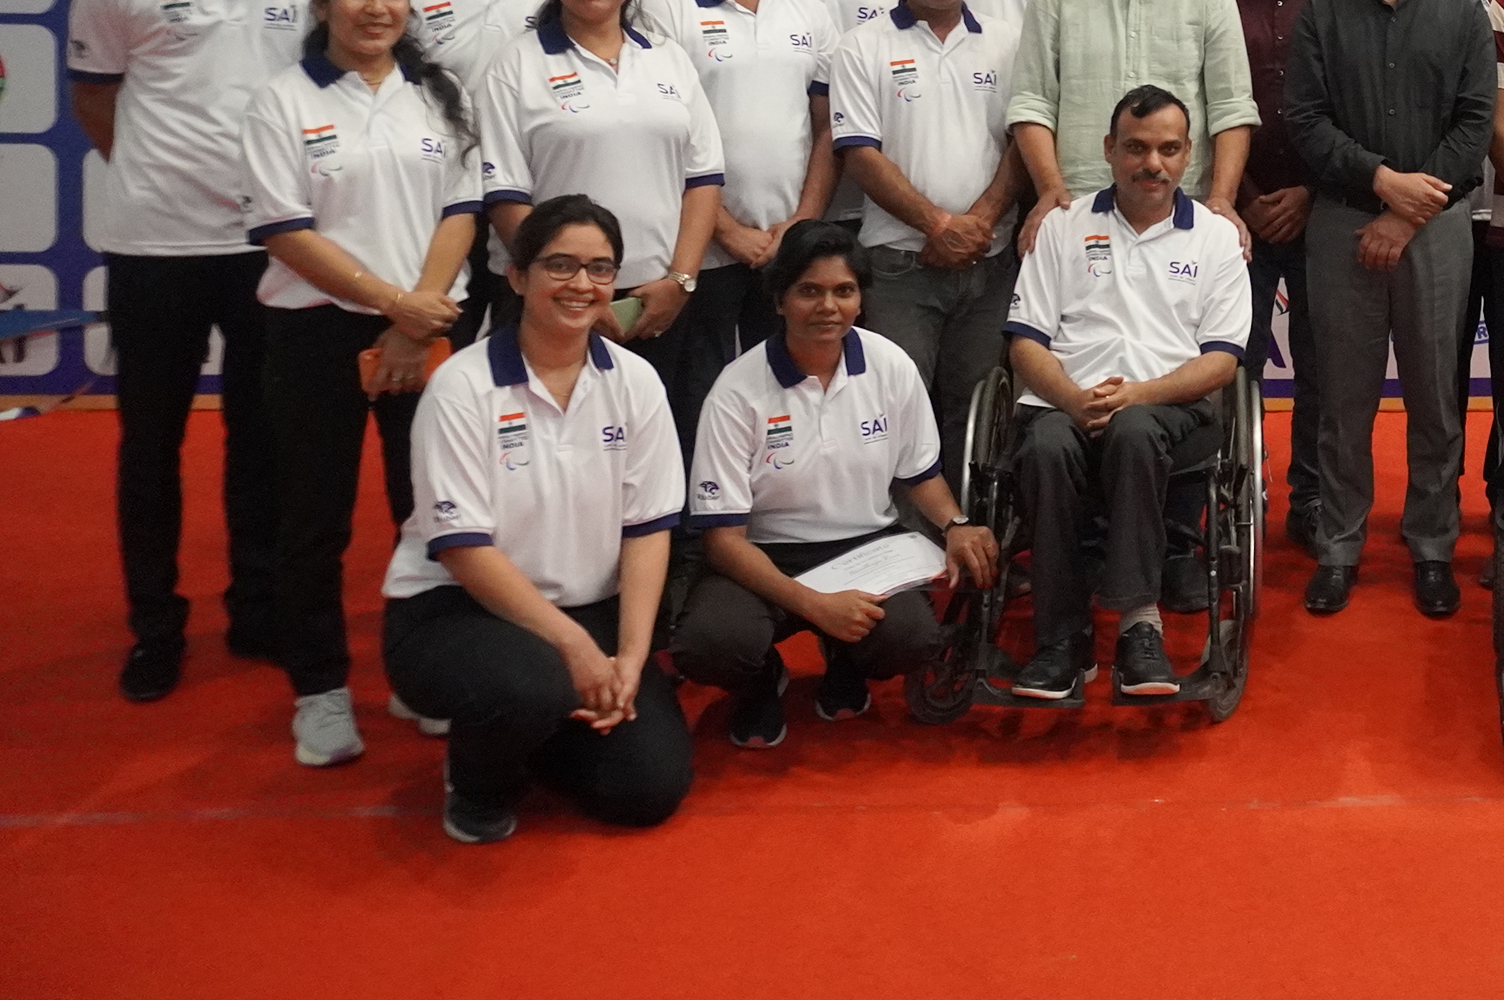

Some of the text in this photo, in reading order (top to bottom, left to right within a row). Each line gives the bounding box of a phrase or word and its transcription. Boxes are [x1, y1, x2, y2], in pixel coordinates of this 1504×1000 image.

[264, 7, 296, 23] SAI
[790, 34, 812, 48] SAI
[973, 73, 996, 86] SAI
[422, 138, 446, 157] SAI
[1169, 262, 1198, 278] SAI
[860, 417, 888, 437] SAI
